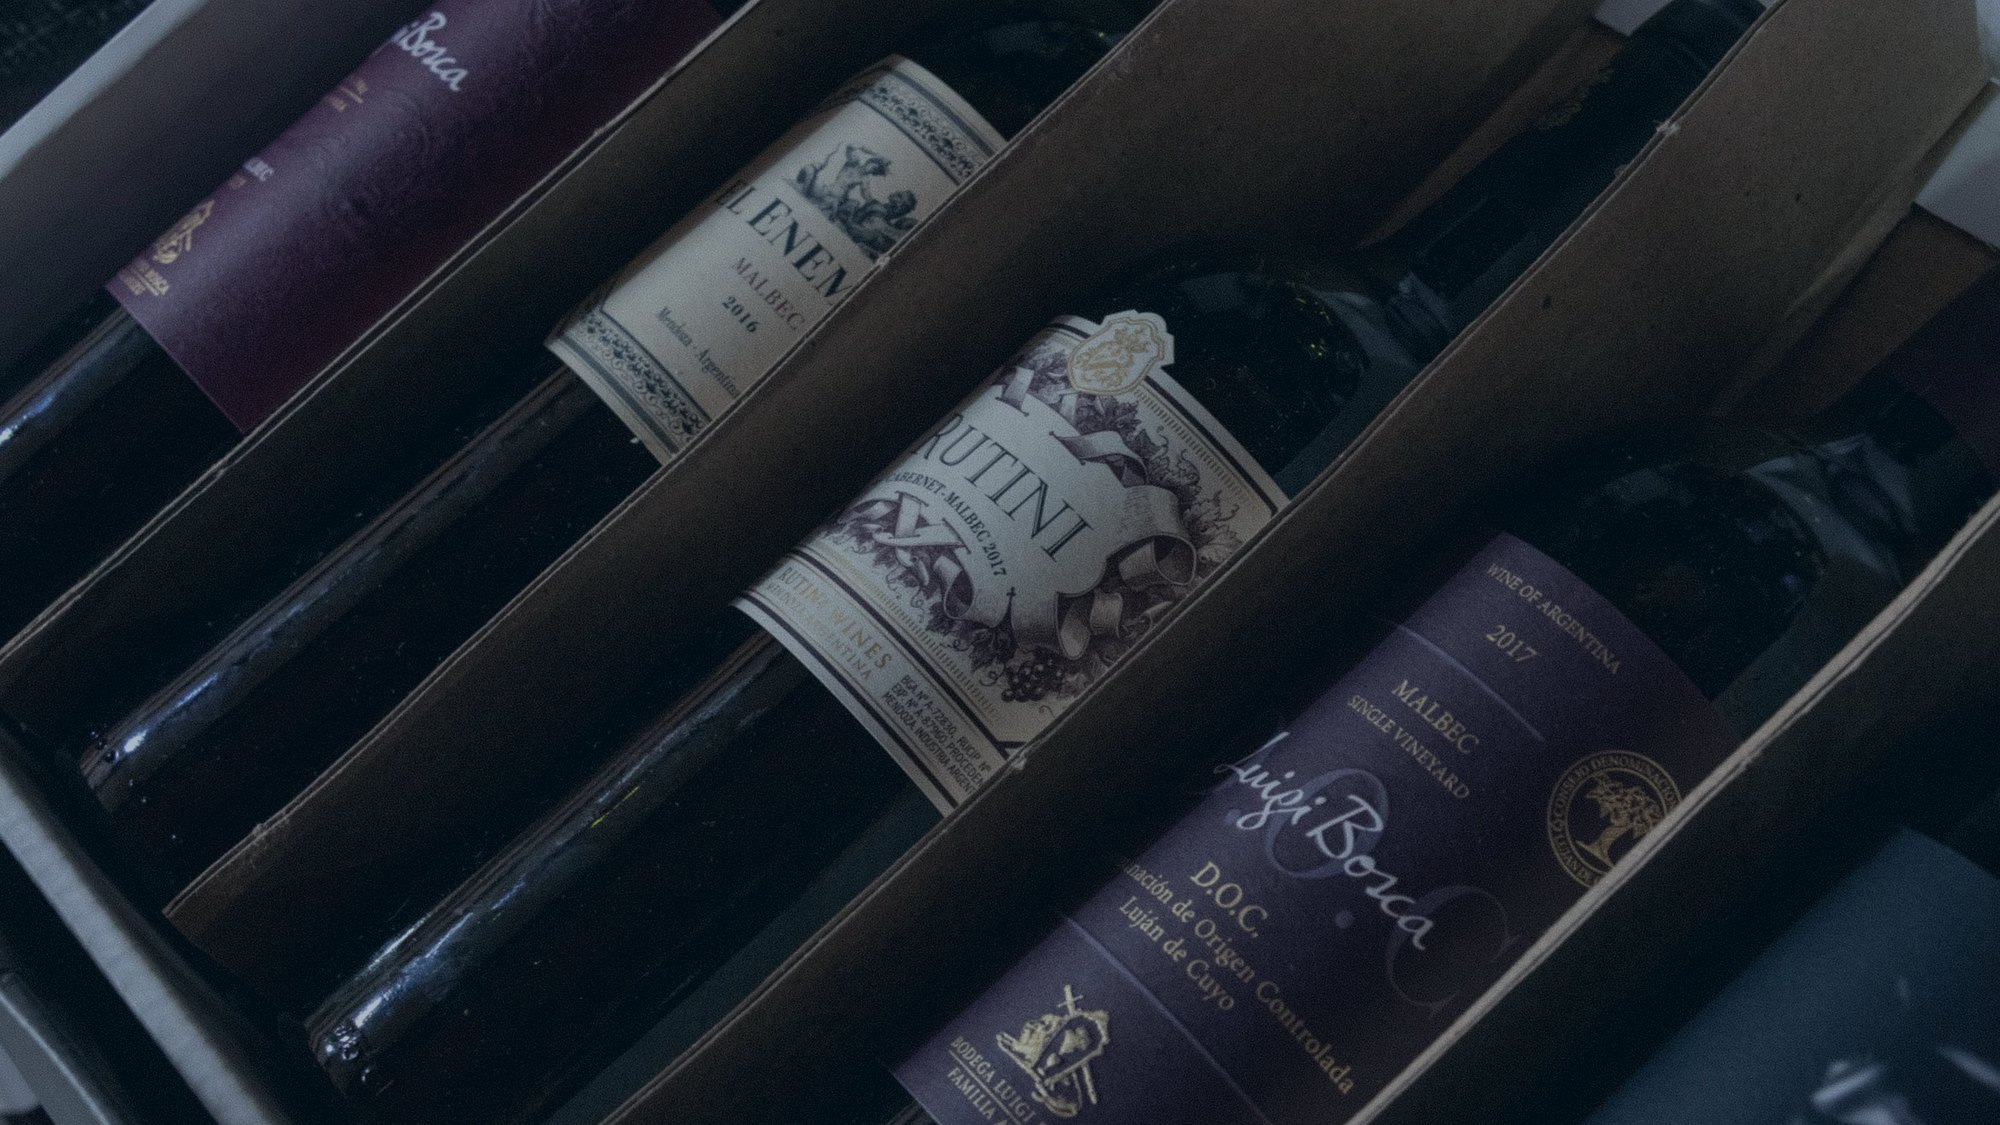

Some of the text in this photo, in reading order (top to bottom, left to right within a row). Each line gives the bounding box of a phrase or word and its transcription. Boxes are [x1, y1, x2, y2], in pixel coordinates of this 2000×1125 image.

[400, 11, 468, 92] Bosca
[657, 306, 693, 348] Mendoza
[722, 295, 760, 334] 2016
[732, 256, 806, 332] MALBEC
[911, 413, 1095, 564] RUTINI
[982, 542, 1007, 577] 2017
[831, 606, 892, 668] WINES
[1485, 623, 1538, 664] 2017
[1486, 562, 1621, 675] WINE OF ARGENTINA
[915, 726, 951, 768] INDUSTRIA
[1347, 694, 1470, 799] SINGLE VINEYARD
[1391, 679, 1480, 754] MALBEC
[1213, 731, 1435, 951] Luigi Bosca
[1190, 860, 1269, 939] D.O.C.
[1119, 896, 1235, 1011] Luján de Cuyo
[1171, 899, 1196, 924] de
[1194, 918, 1256, 983] Origen
[1255, 980, 1355, 1095] Controlada
[947, 1067, 997, 1120] FAMILIA
[950, 1035, 1037, 1122] BODEGA LUIGI
